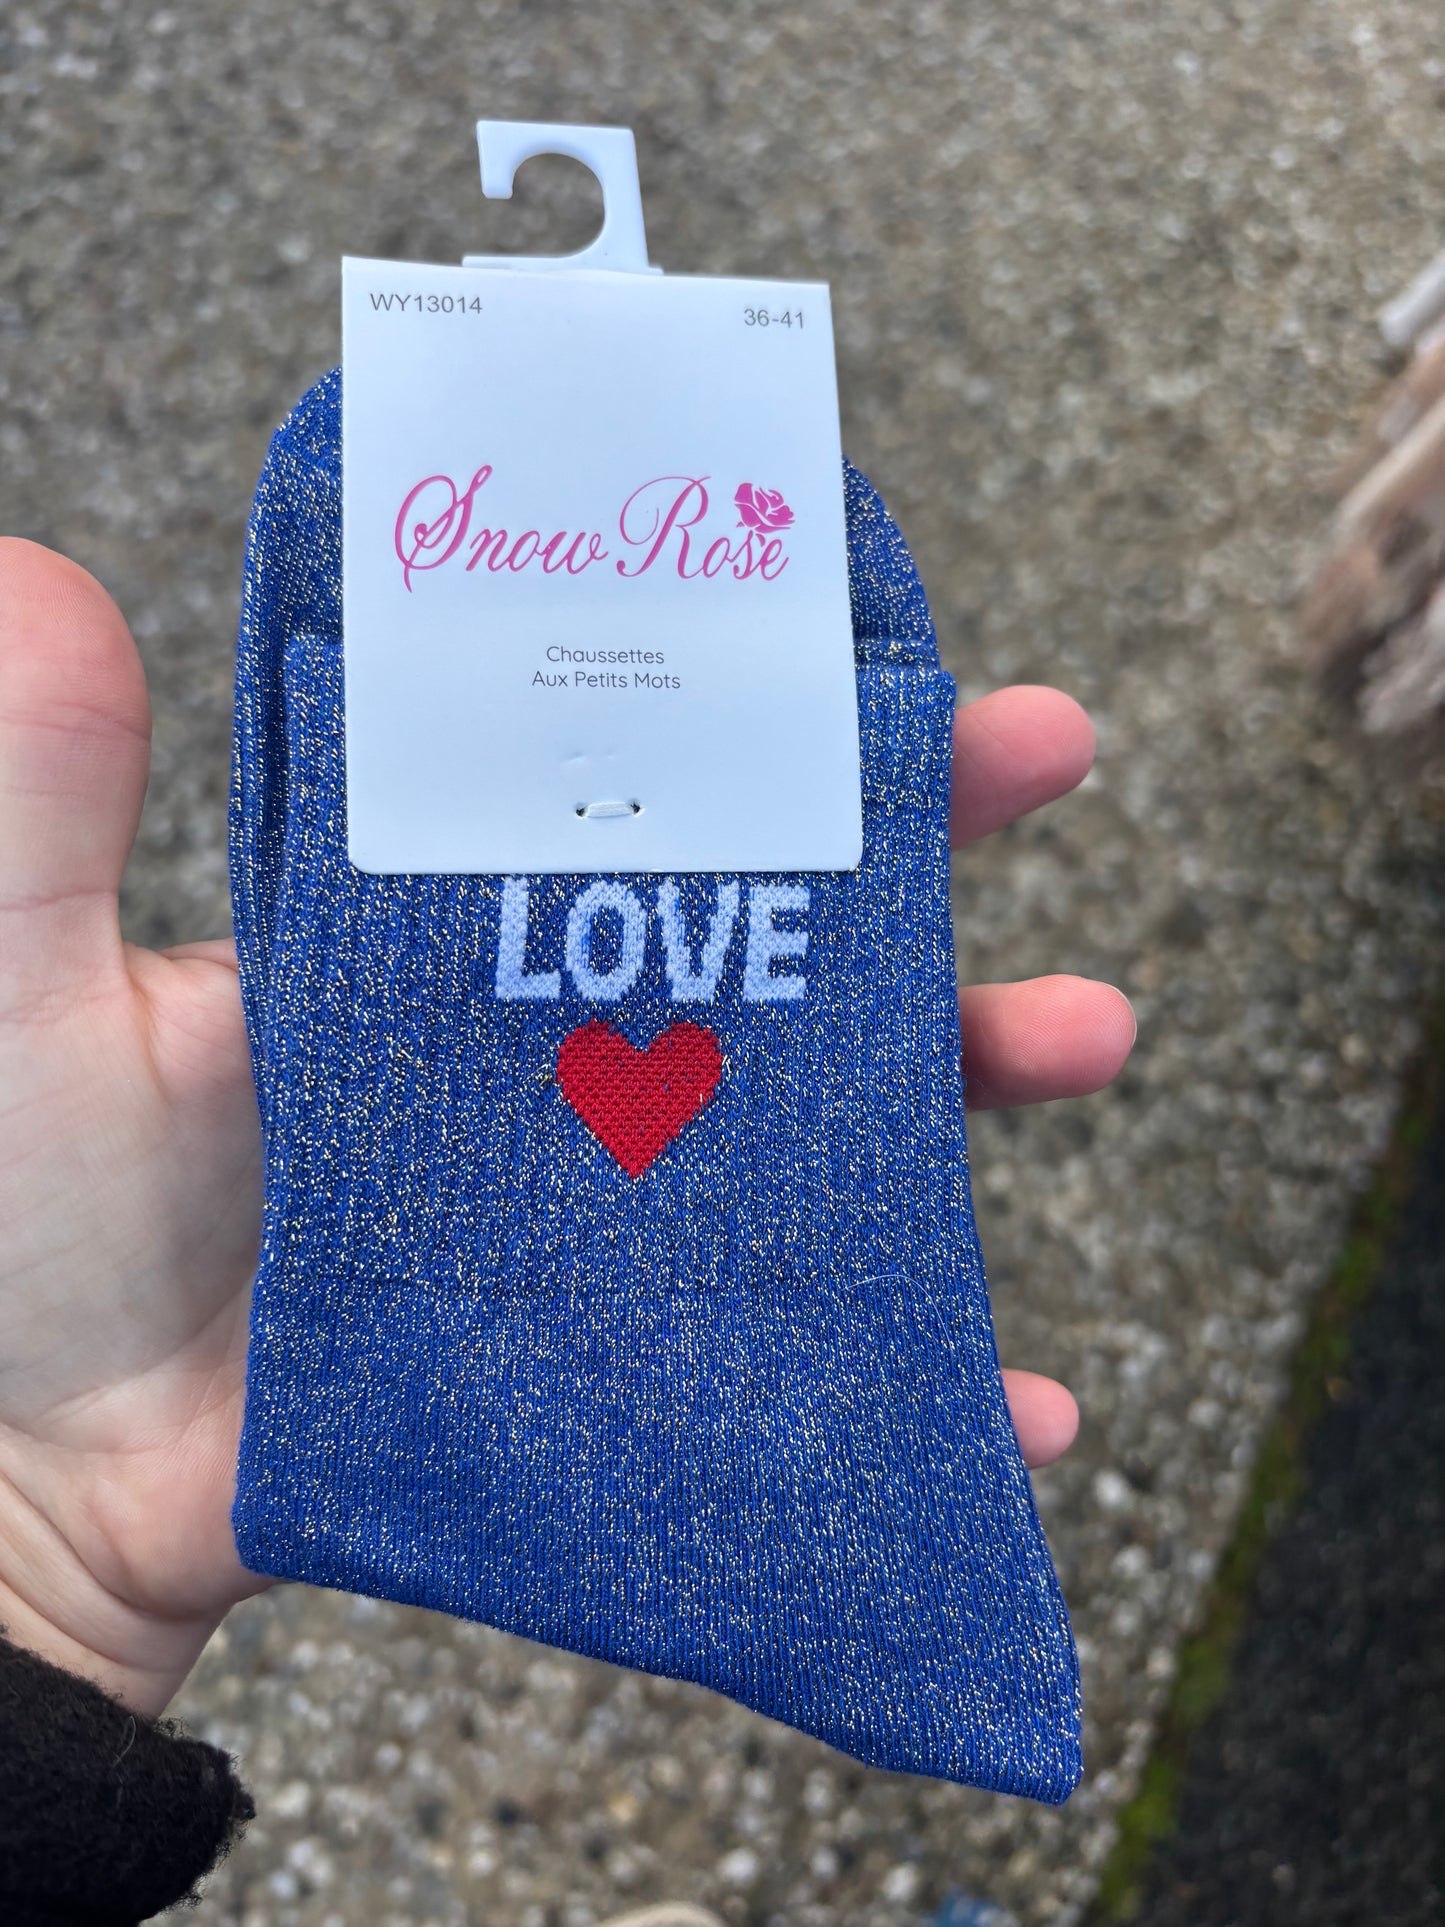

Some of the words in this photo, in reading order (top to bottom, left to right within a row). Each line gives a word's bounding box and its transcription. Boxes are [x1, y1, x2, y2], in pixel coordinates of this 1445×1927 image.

[370, 292, 484, 315] WY13014
[743, 307, 805, 330] 36-41
[394, 464, 609, 594] Snow
[616, 475, 791, 582] Rose
[545, 645, 666, 666] Chaussettes
[531, 669, 569, 689] Aux
[574, 670, 629, 690] Petits
[633, 671, 682, 691] Mots
[494, 876, 812, 1002] LOVE
